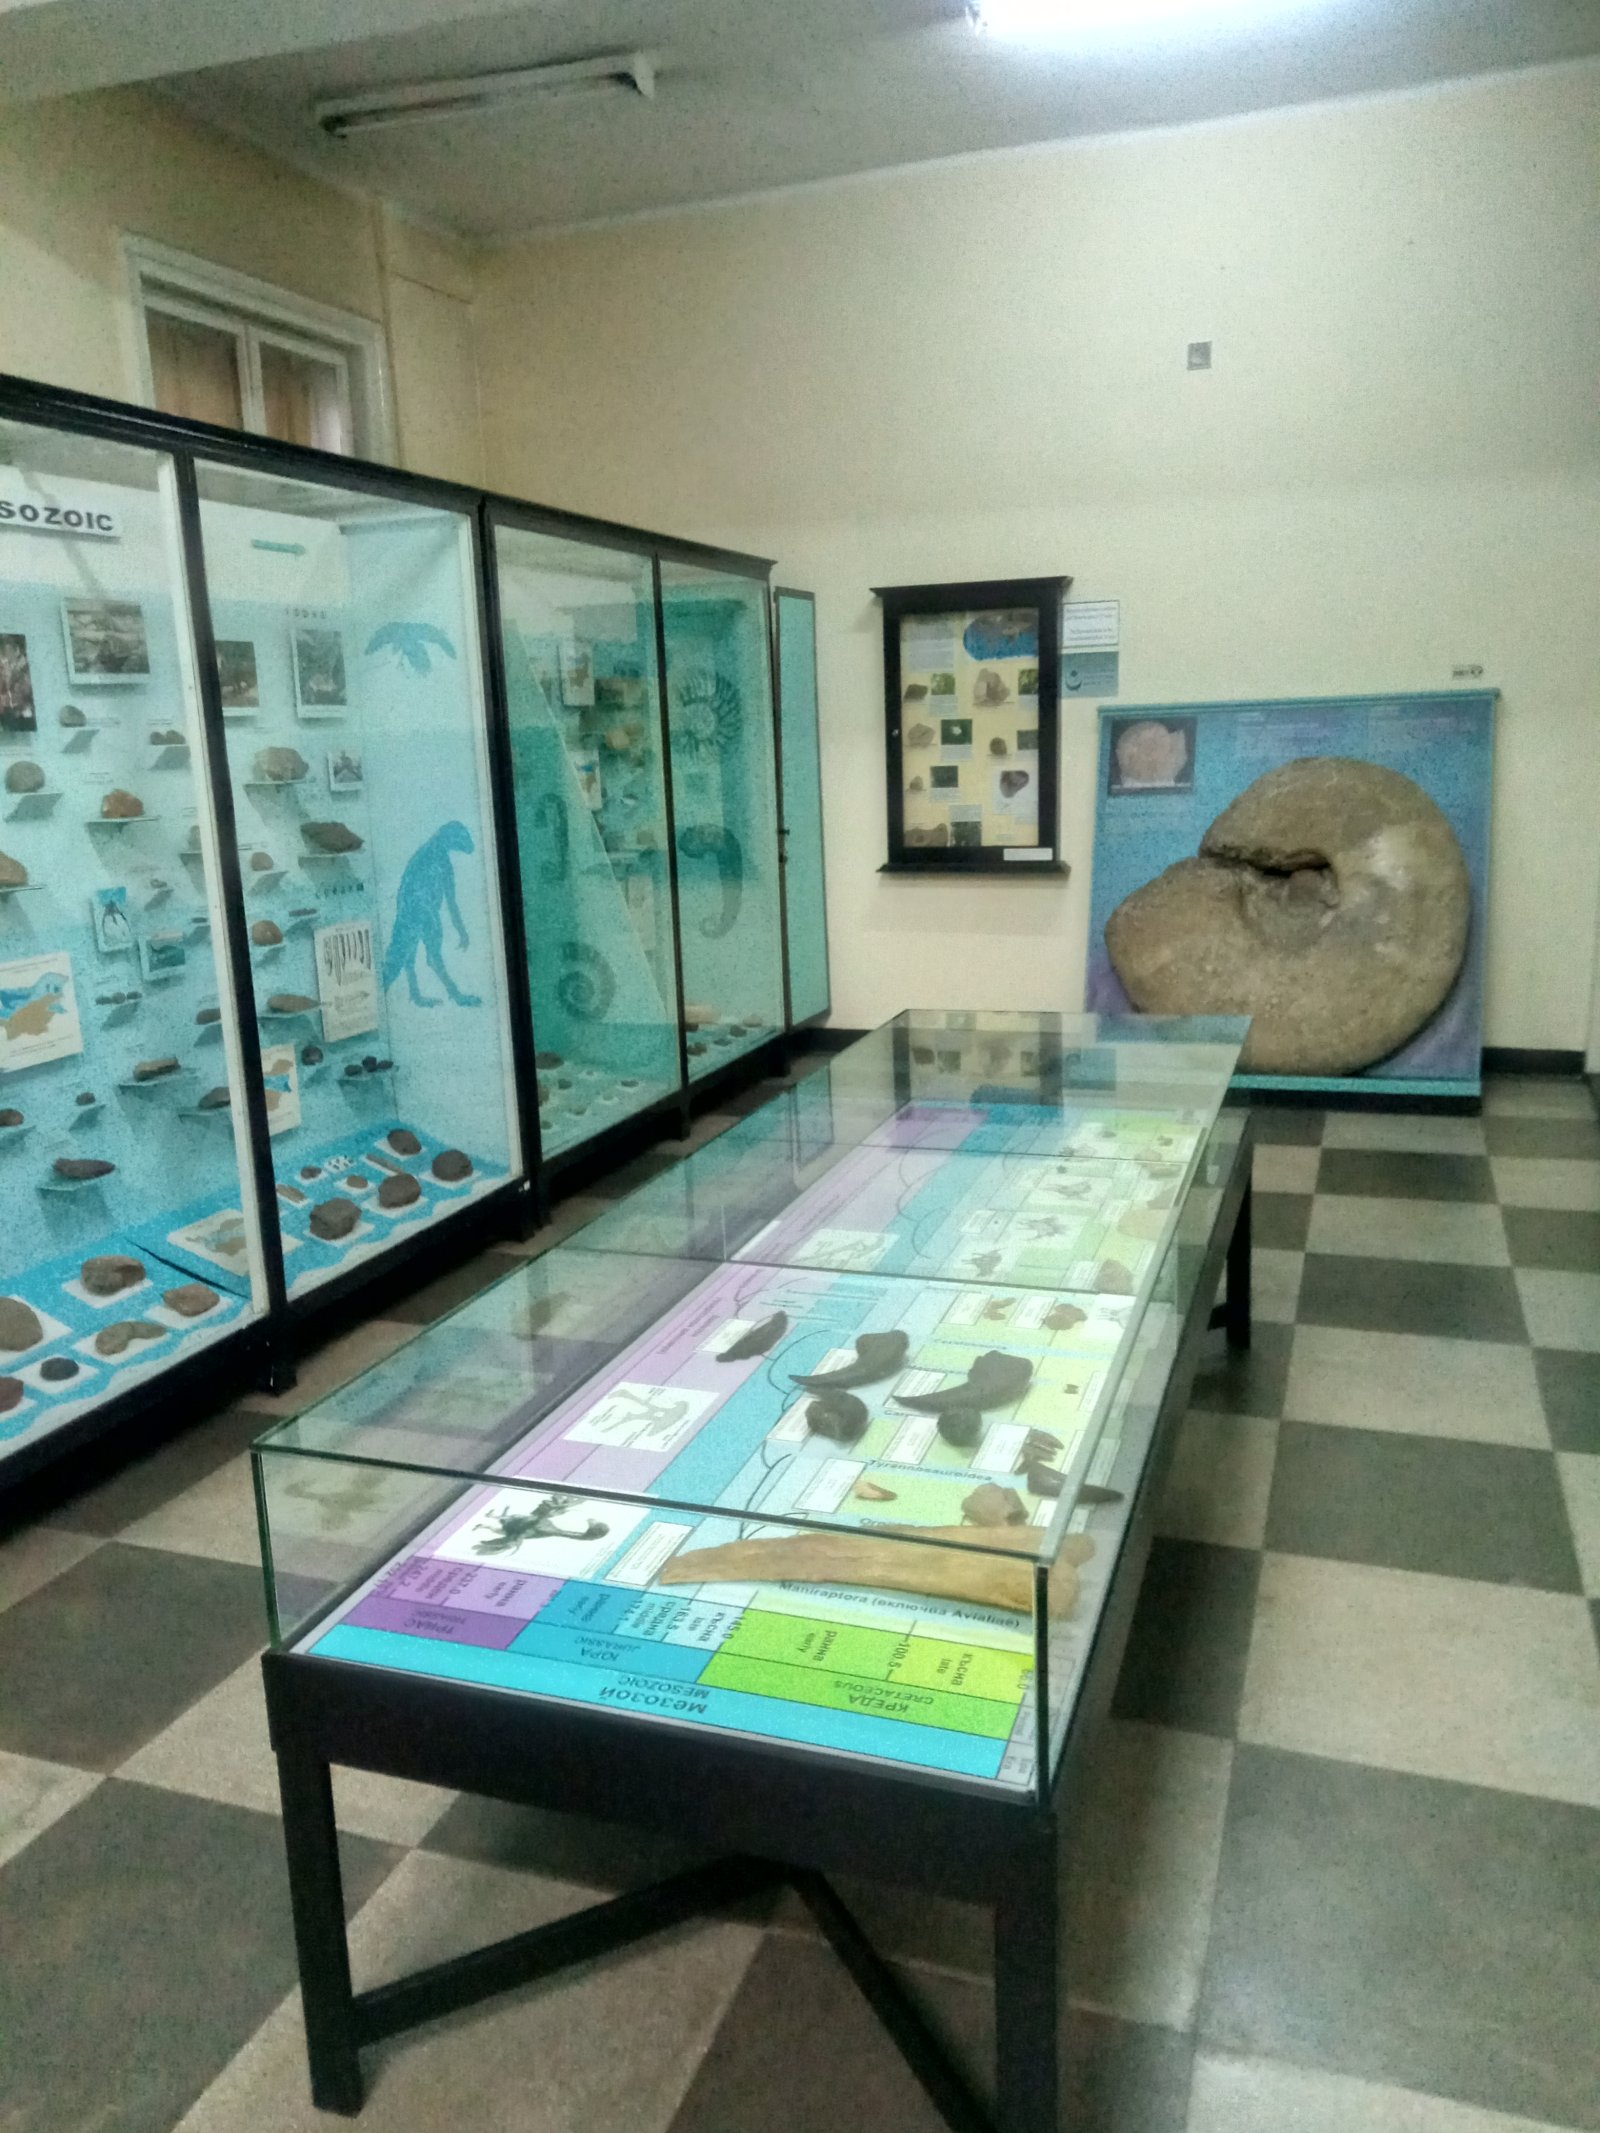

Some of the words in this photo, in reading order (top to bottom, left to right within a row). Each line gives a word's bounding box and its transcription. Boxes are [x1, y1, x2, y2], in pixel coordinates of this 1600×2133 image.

[698, 1611, 726, 1643] късна
[813, 1630, 838, 1662] ранна
[951, 1653, 974, 1686] късна
[618, 1675, 711, 1700] MESOZOIC
[834, 1679, 935, 1705] CRETACEOUS
[849, 1693, 909, 1714] КРЕДА
